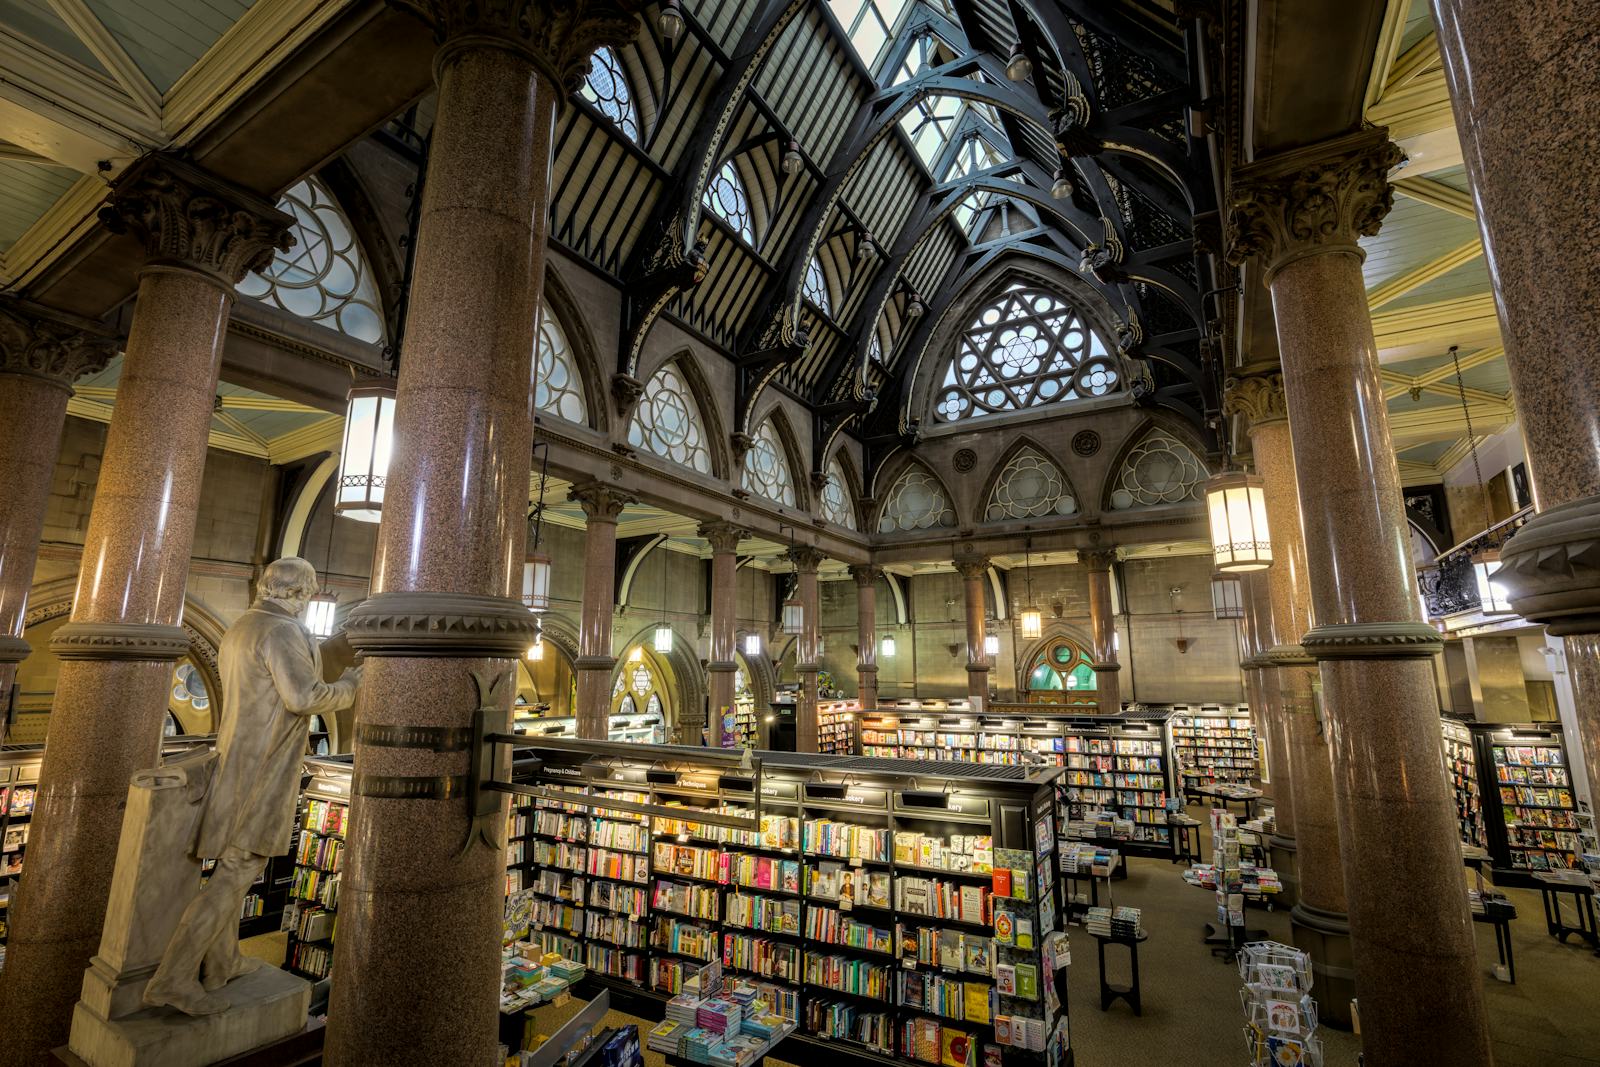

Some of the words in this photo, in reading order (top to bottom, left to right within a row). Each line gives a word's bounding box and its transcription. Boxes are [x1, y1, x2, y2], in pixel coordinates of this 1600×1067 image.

[543, 766, 562, 774] Pregnancy
[682, 780, 706, 789] Techniques
[948, 802, 962, 812] kery
